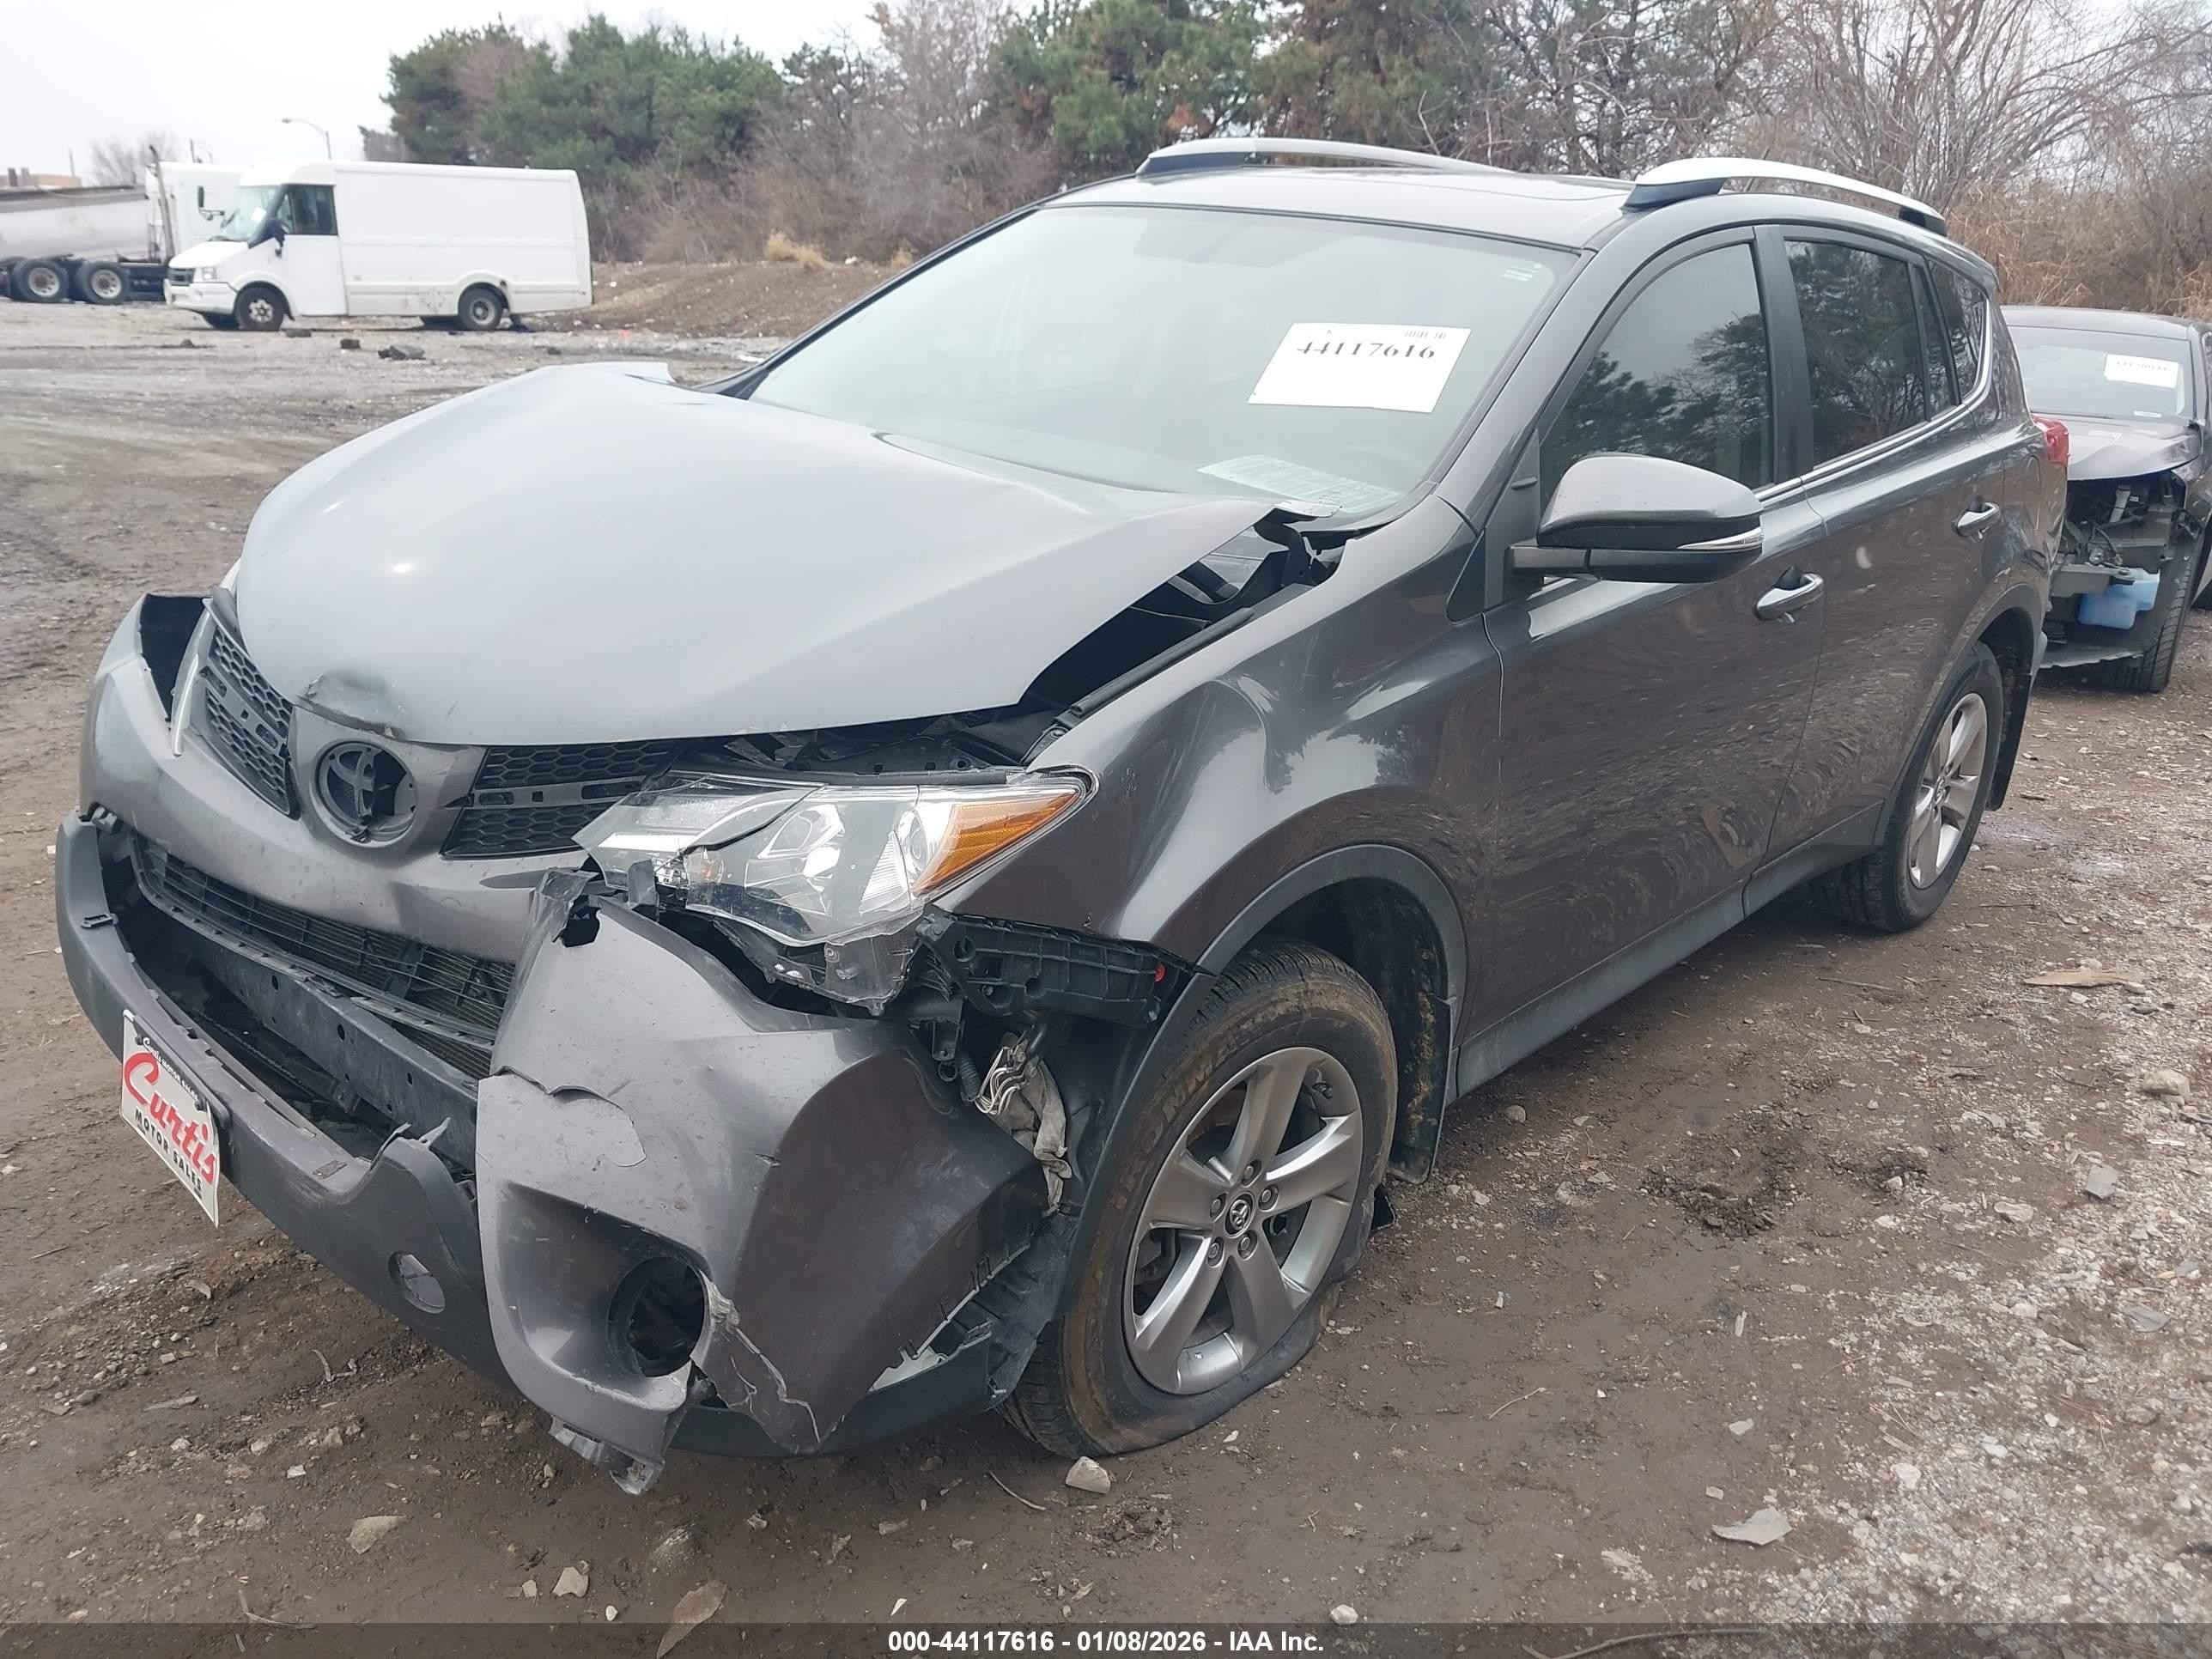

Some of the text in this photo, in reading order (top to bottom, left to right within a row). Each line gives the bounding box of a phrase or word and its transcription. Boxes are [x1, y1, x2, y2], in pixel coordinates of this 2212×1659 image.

[1297, 340, 1436, 359] 44117616
[124, 1052, 216, 1185] Curtis
[134, 1108, 203, 1191] MOTOR SALES
